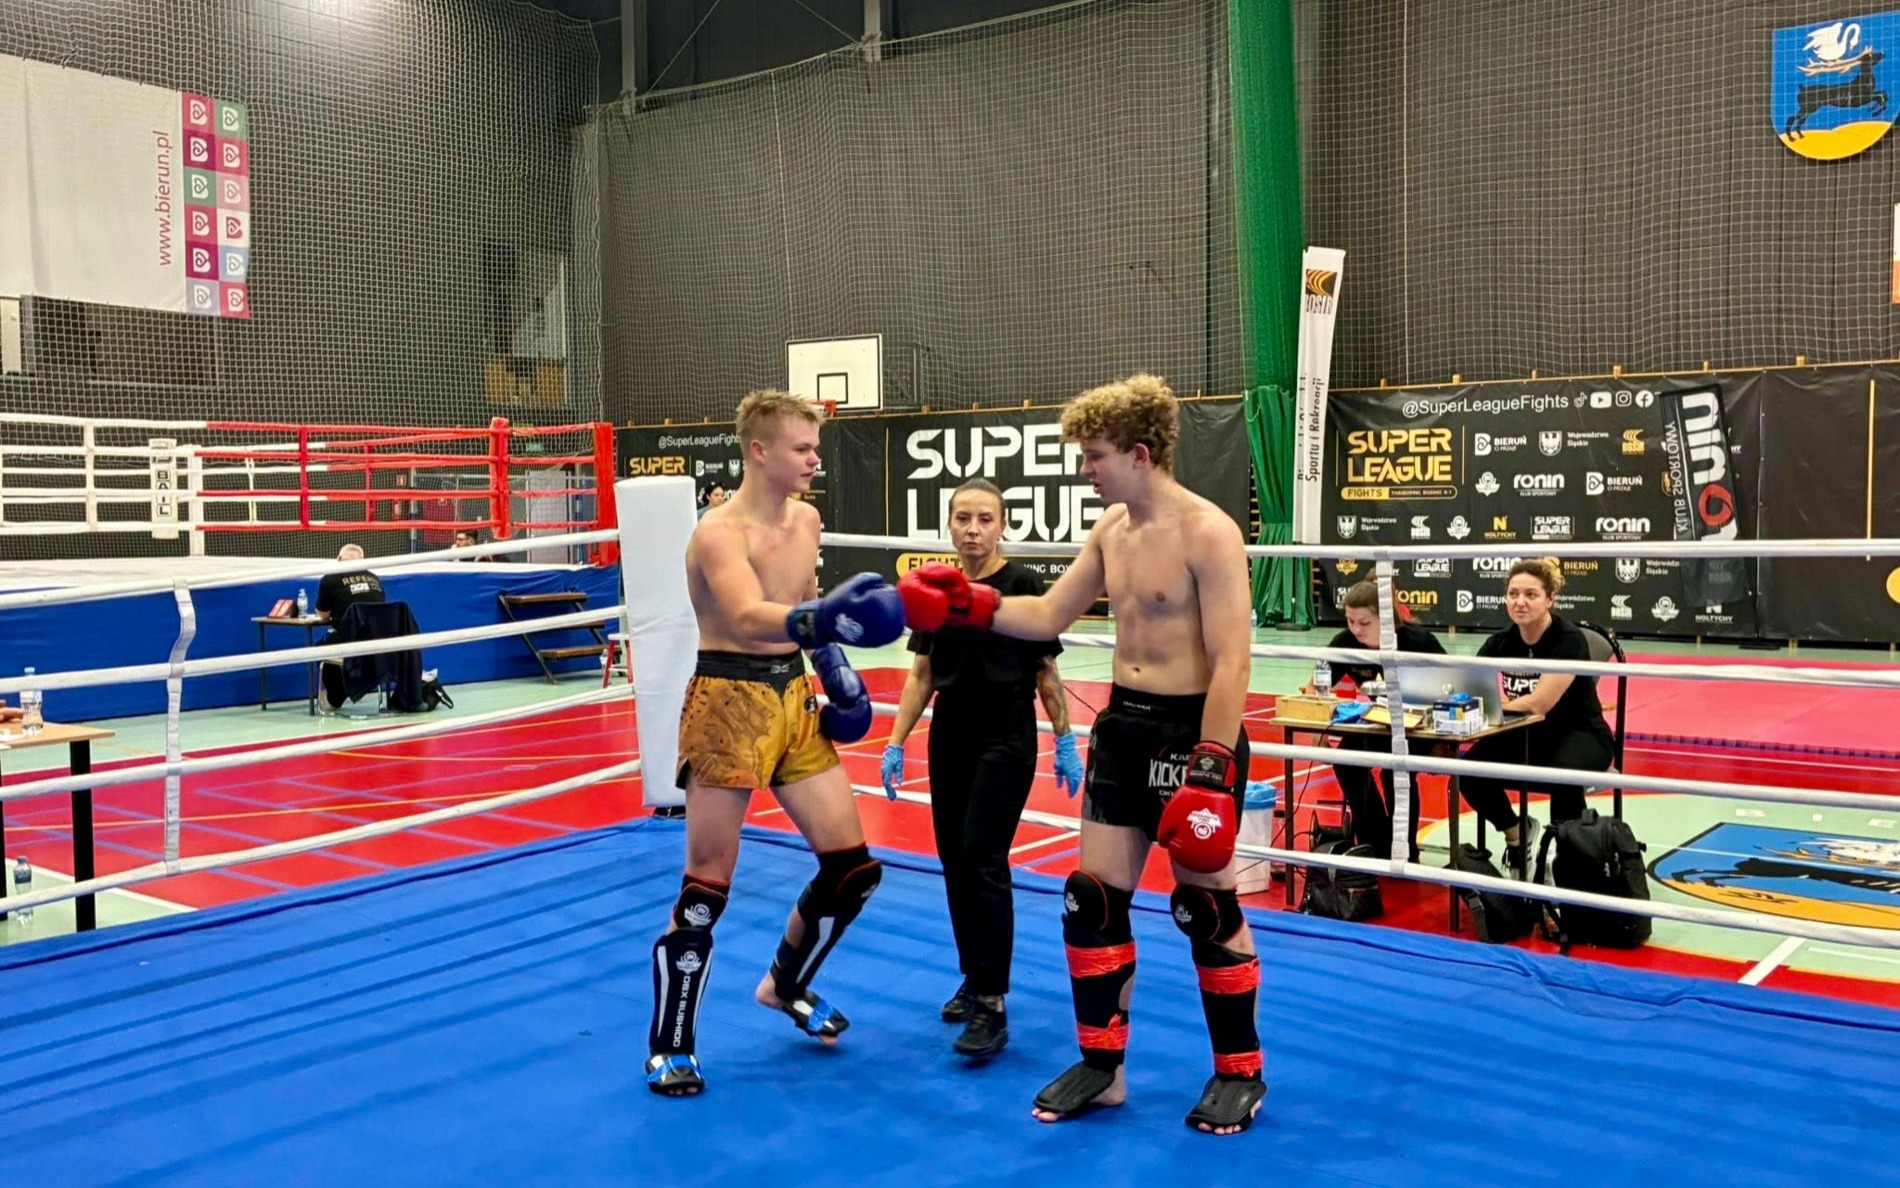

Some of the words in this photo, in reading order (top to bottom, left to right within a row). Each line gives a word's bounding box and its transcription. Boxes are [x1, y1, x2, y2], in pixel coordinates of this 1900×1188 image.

[153, 130, 173, 266] www.bierun.pl
[1402, 393, 1569, 418] @SuperLeagueFights
[1347, 427, 1452, 454] SUPER
[629, 456, 686, 475] SUPER
[1305, 444, 1321, 482] Sportu
[1347, 456, 1452, 484] LEAGUE
[1513, 474, 1565, 489] ronin
[1607, 475, 1643, 486] BIERUŃ
[1347, 488, 1383, 498] FIGHTS
[907, 485, 1107, 542] LEGUE
[1534, 516, 1571, 525] SUPER
[1596, 517, 1650, 533] ronin
[1395, 589, 1438, 605] onin
